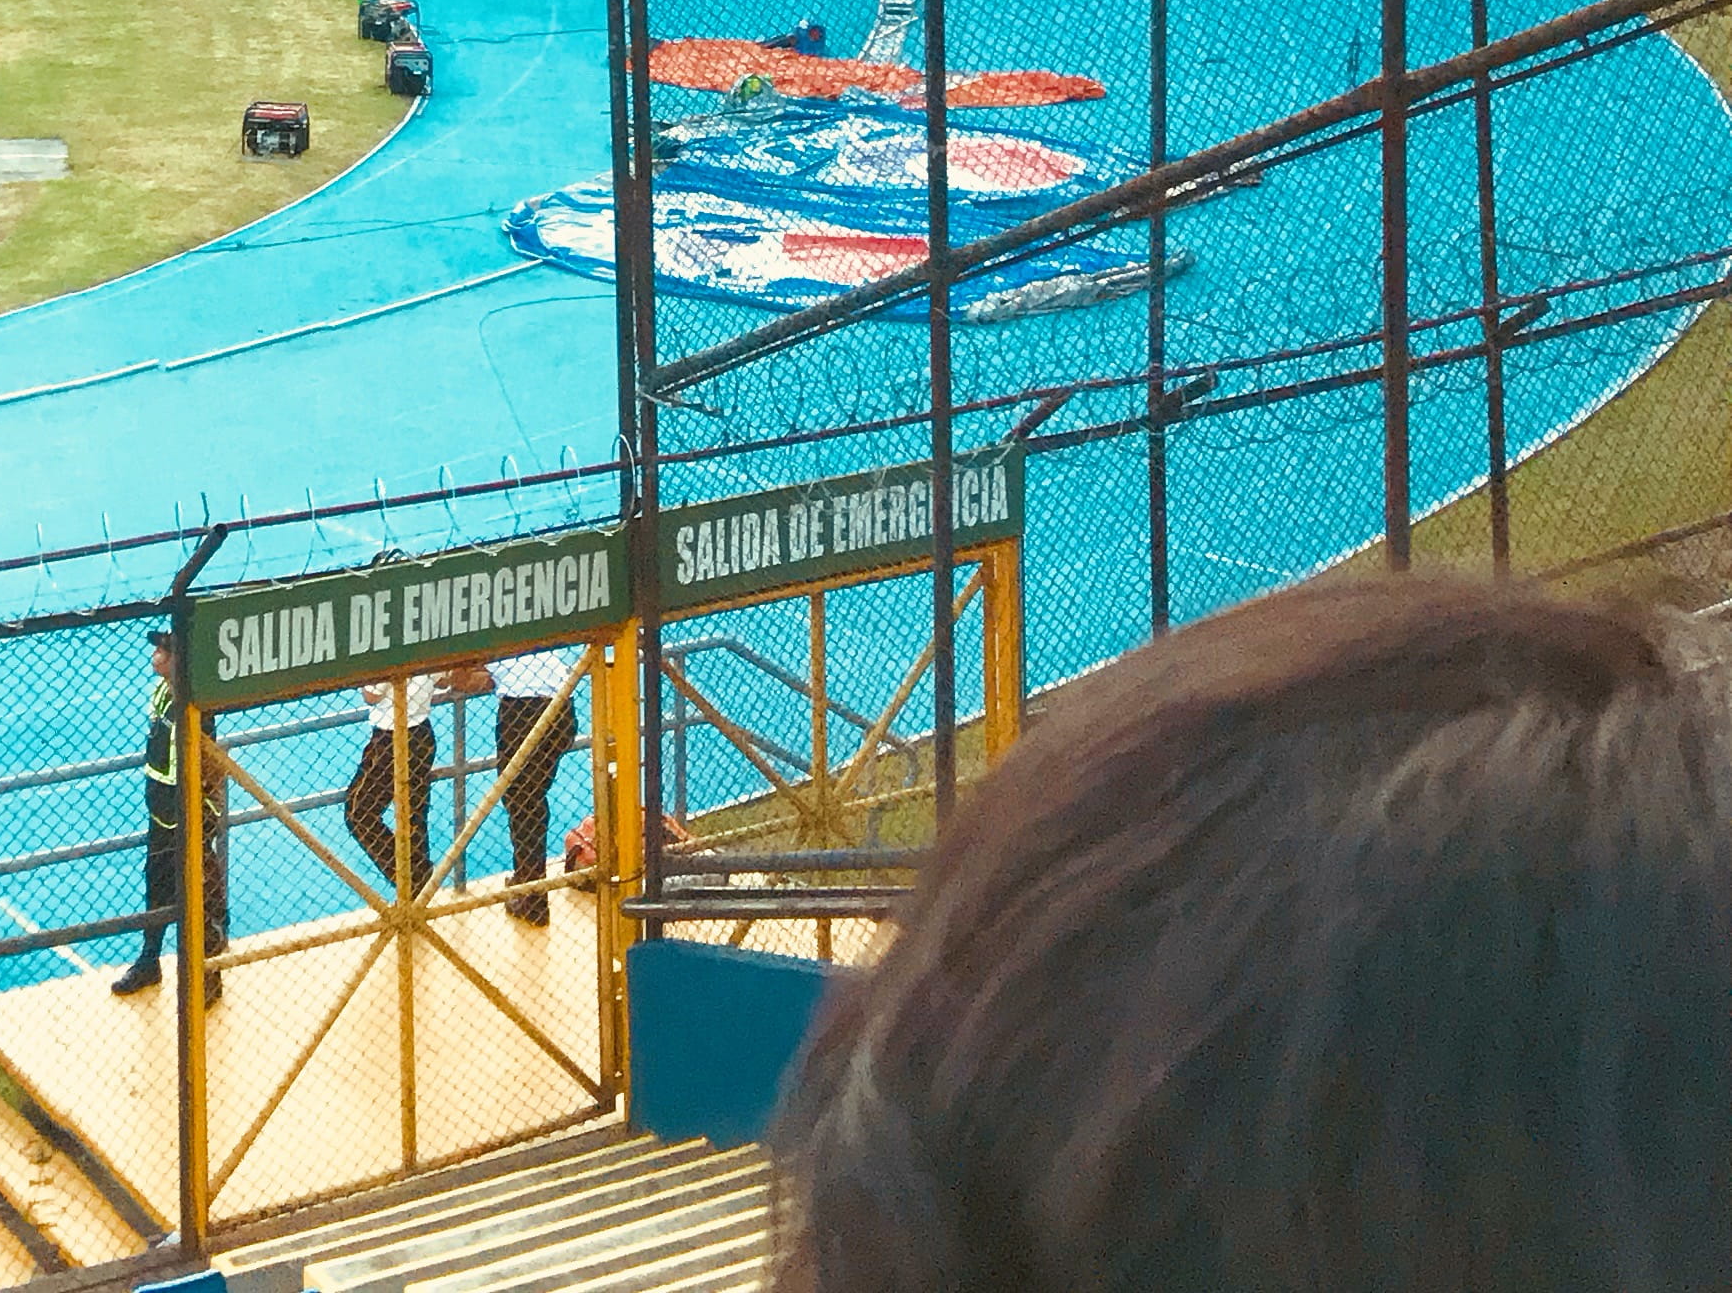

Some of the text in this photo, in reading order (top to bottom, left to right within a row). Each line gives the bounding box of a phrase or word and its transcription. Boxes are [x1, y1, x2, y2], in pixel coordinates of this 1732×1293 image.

[676, 507, 782, 586] SALIDA
[787, 499, 826, 562] DE
[217, 549, 611, 683] SALIDA DE EMERGENCIA
